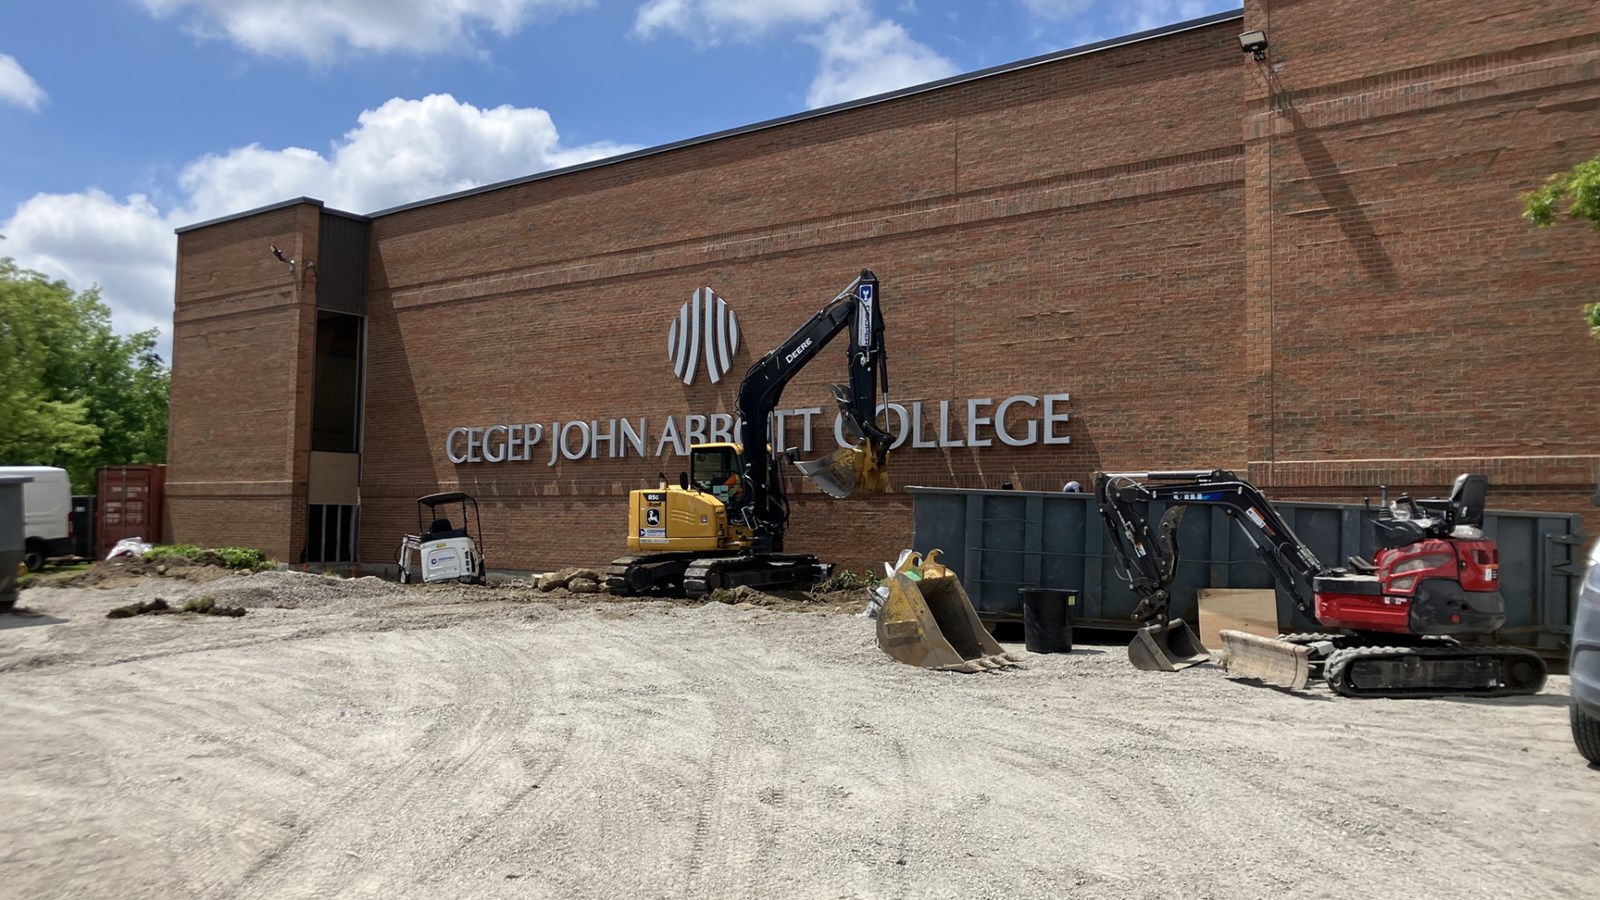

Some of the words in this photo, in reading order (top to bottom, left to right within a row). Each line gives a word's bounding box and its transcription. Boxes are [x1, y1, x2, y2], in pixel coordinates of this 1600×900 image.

[785, 337, 813, 364] DEERE
[446, 422, 544, 464] CEGEP
[547, 417, 648, 467] JOHN
[655, 407, 822, 457] ABBTT
